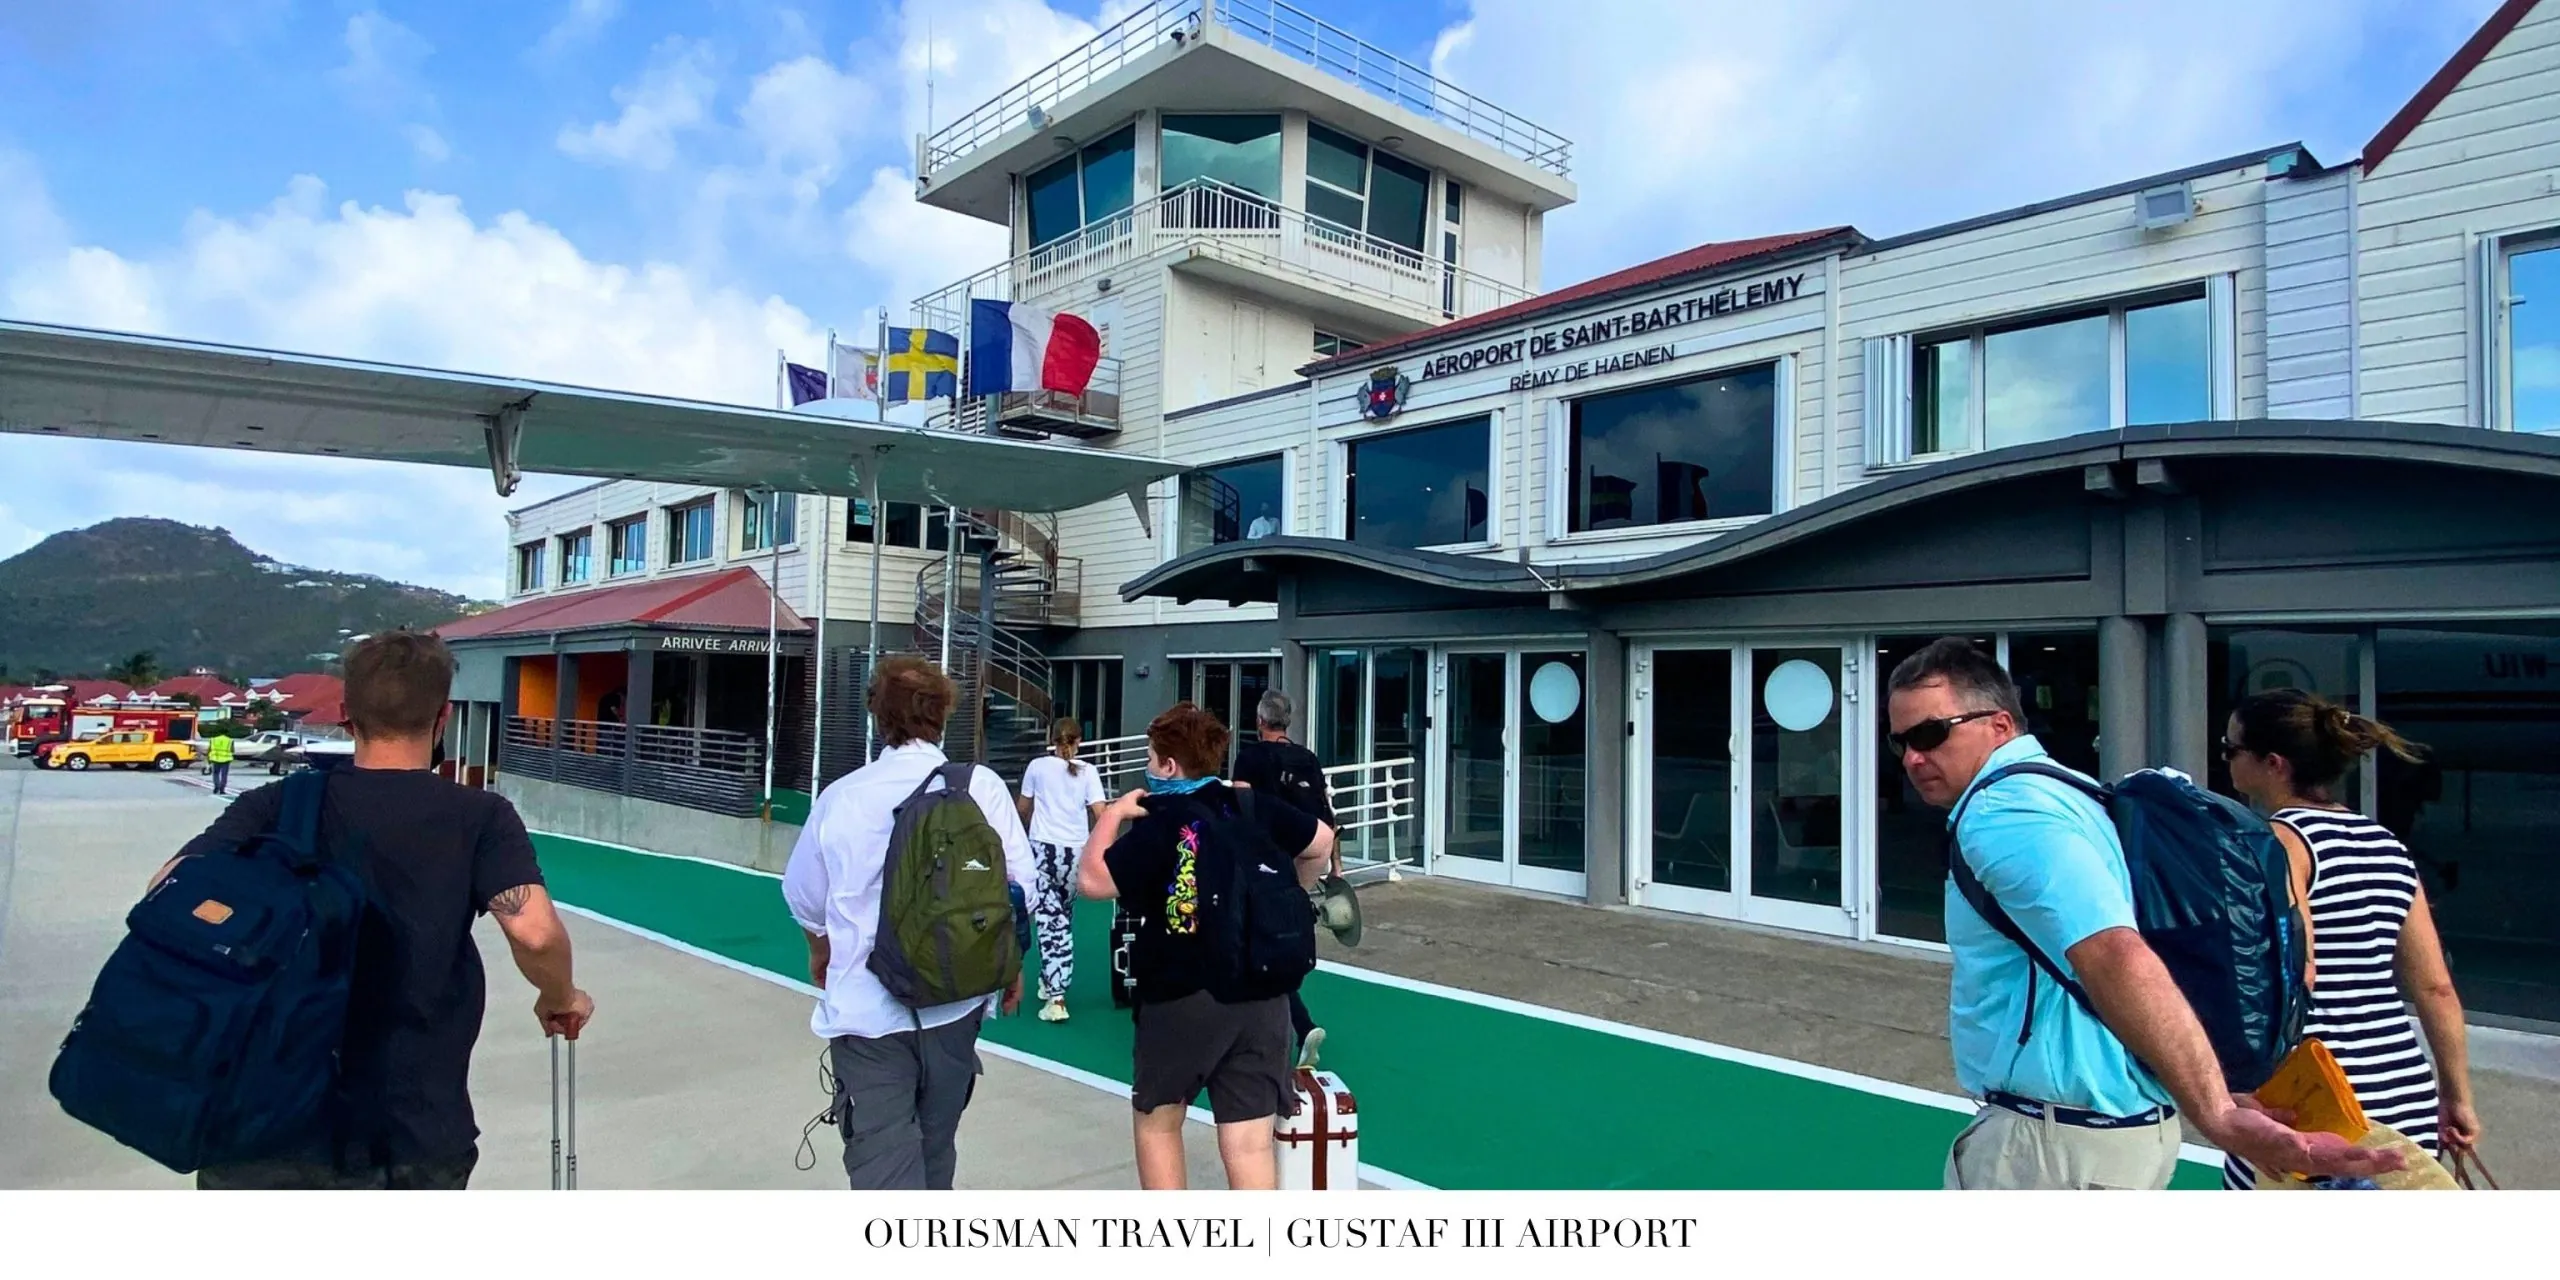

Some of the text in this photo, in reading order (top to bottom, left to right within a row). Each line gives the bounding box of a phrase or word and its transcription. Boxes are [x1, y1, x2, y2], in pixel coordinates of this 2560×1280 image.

[1422, 273, 1805, 380] AÉROPORT DE SAINT-BARTHÉLEMY
[1509, 344, 1675, 393] RÉMY DE HAENEN
[661, 635, 721, 651] ARRIVÉE
